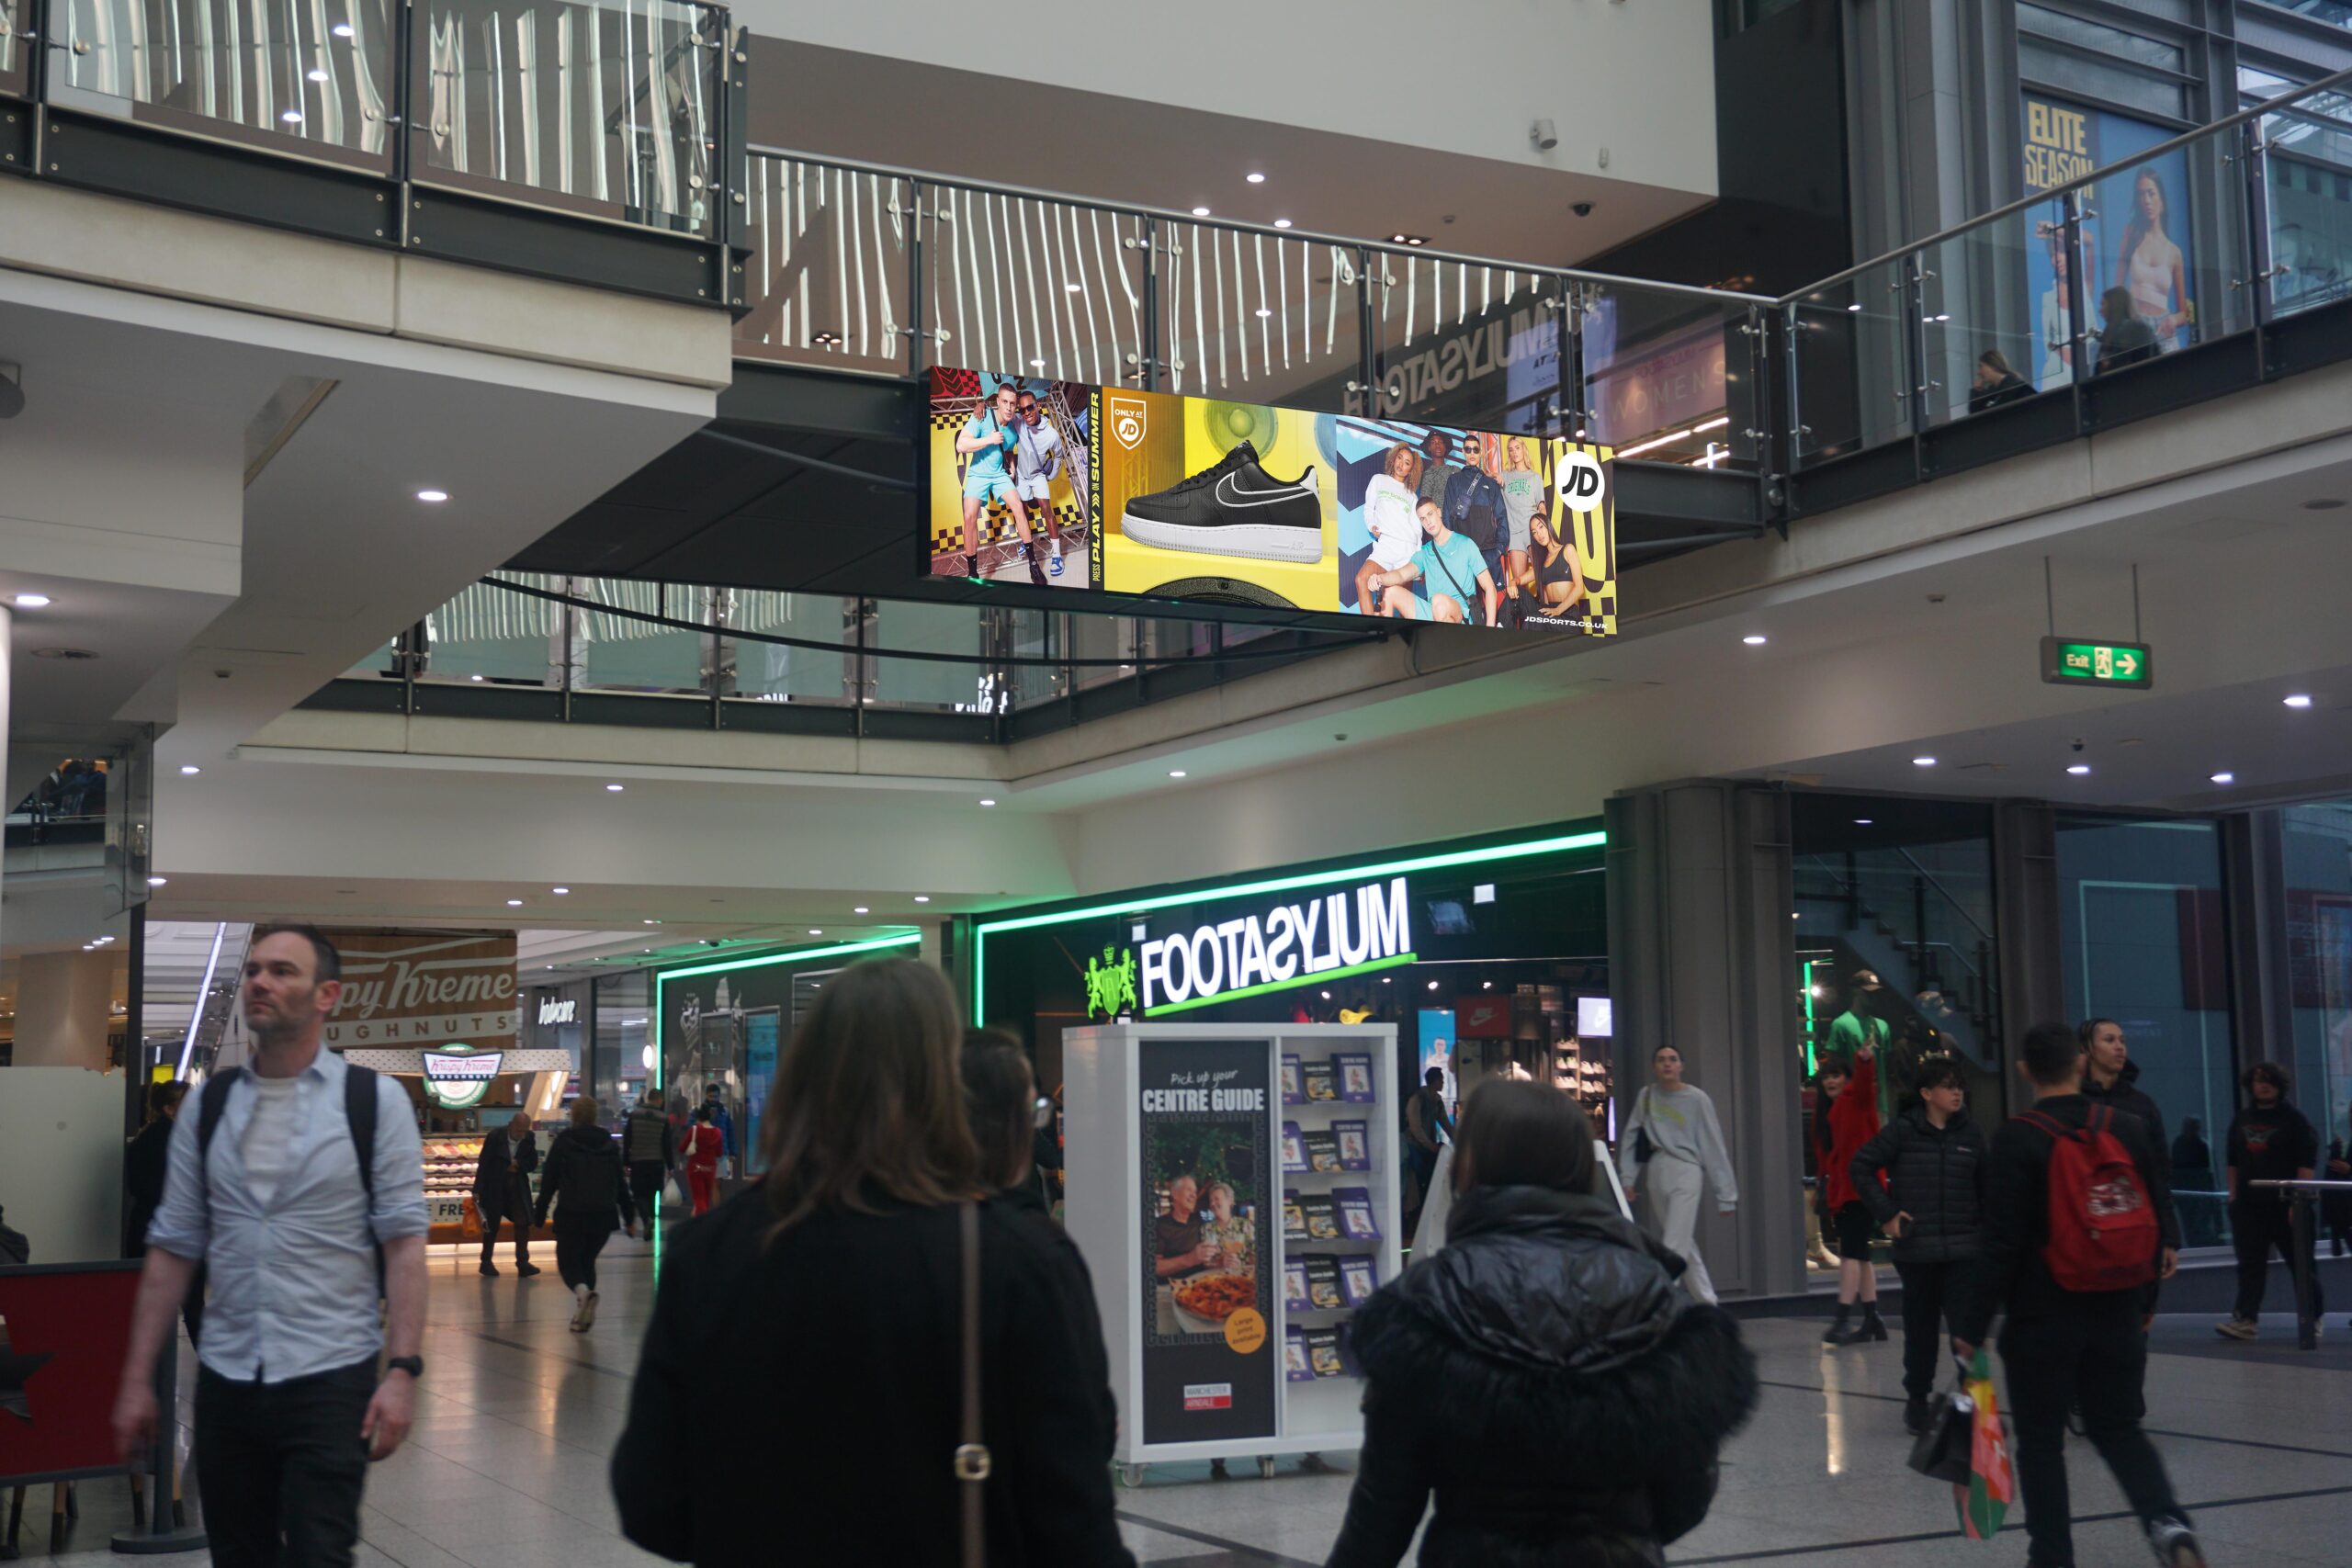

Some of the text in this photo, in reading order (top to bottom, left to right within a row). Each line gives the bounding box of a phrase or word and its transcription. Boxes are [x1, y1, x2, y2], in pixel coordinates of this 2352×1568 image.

[2028, 101, 2087, 155] ELITE
[1114, 408, 1136, 417] ONLY
[1091, 391, 1100, 482] SUMMER
[1121, 423, 1137, 435] JD
[1562, 465, 1599, 497] JD
[1091, 510, 1101, 563] PLAY
[1092, 563, 1101, 581] PRESS
[1524, 615, 1609, 629] JDSPORTS.CO.UK
[2065, 653, 2090, 669] Exit
[1141, 876, 1411, 1009] FOOTASYLUM
[326, 1015, 508, 1042] UGHNUTS
[1170, 1069, 1238, 1089] Pick up your
[1142, 1089, 1265, 1112] CENTRE GUIDE
